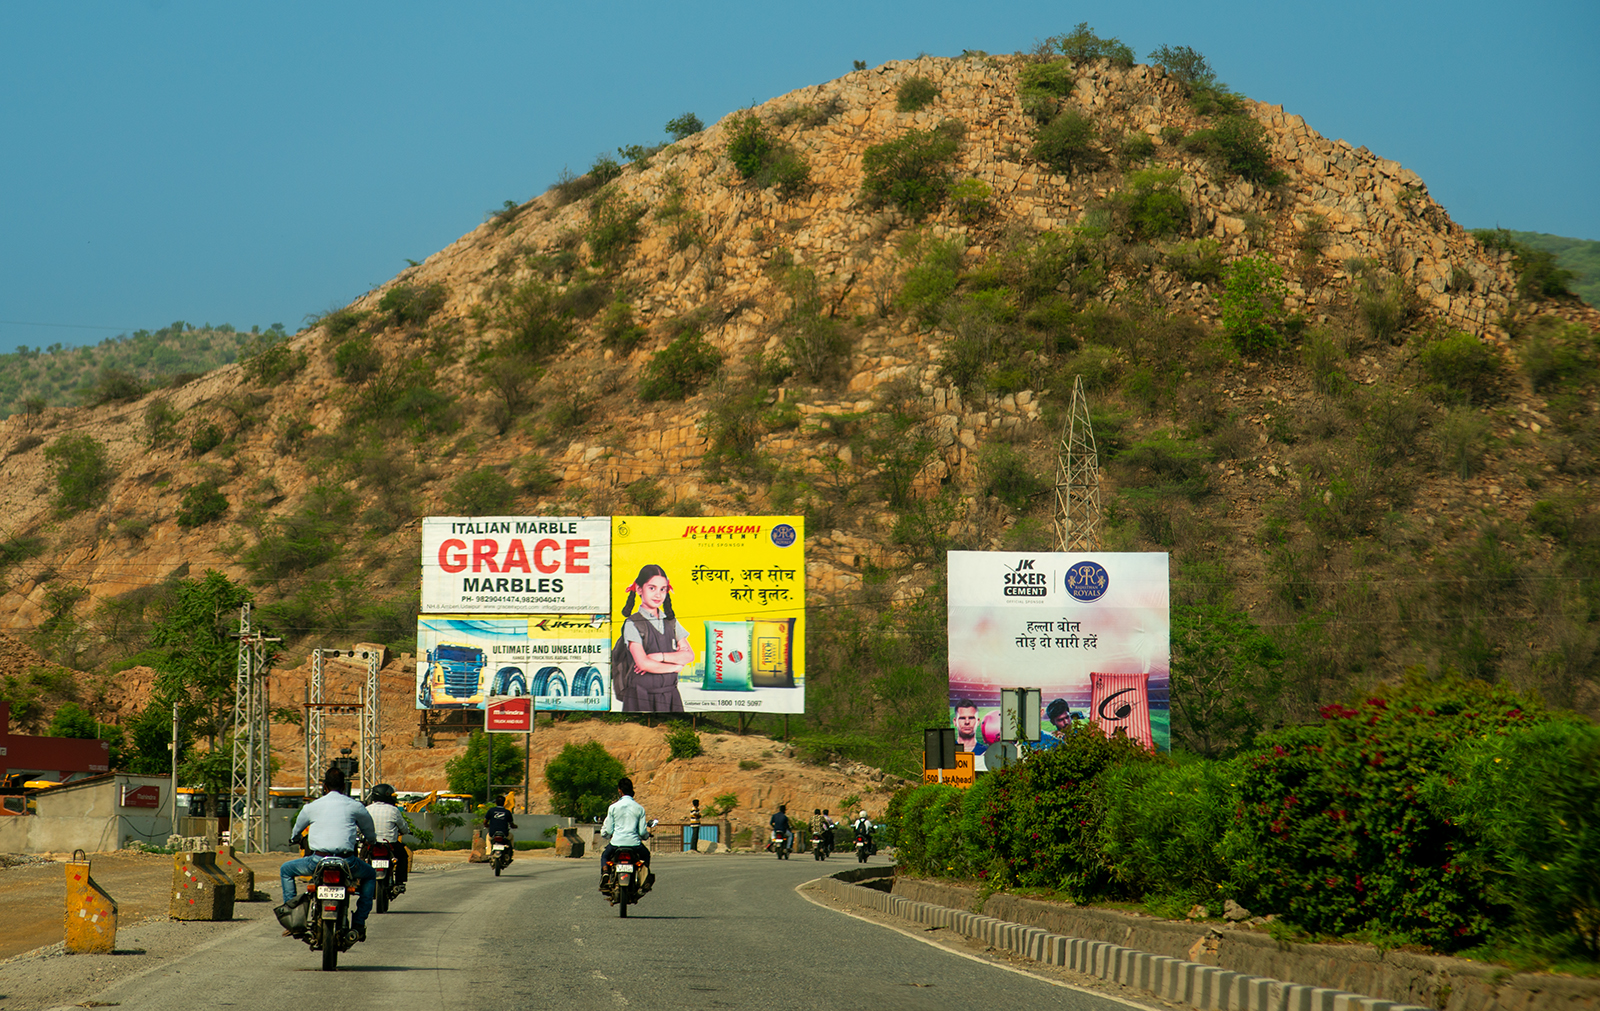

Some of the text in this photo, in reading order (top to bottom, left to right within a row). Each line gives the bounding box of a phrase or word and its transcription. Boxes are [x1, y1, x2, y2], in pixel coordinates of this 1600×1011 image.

[452, 522, 577, 534] ITALIAN MARBLE
[682, 525, 761, 537] JK LAKSHMI
[438, 538, 590, 573] GRACE
[1015, 559, 1036, 571] JK
[691, 564, 796, 585] इंडिया, अब सोच
[1003, 573, 1047, 585] SIXER
[463, 578, 564, 593] MARBLES
[1006, 587, 1044, 595] CEMENT
[730, 584, 794, 606] करो बुलंद.
[1026, 617, 1081, 634] हल्ला बोल
[1015, 633, 1098, 651] तोड़ दो सारी हदें
[492, 645, 602, 654] ULTIMATE AND UNBEATABLE
